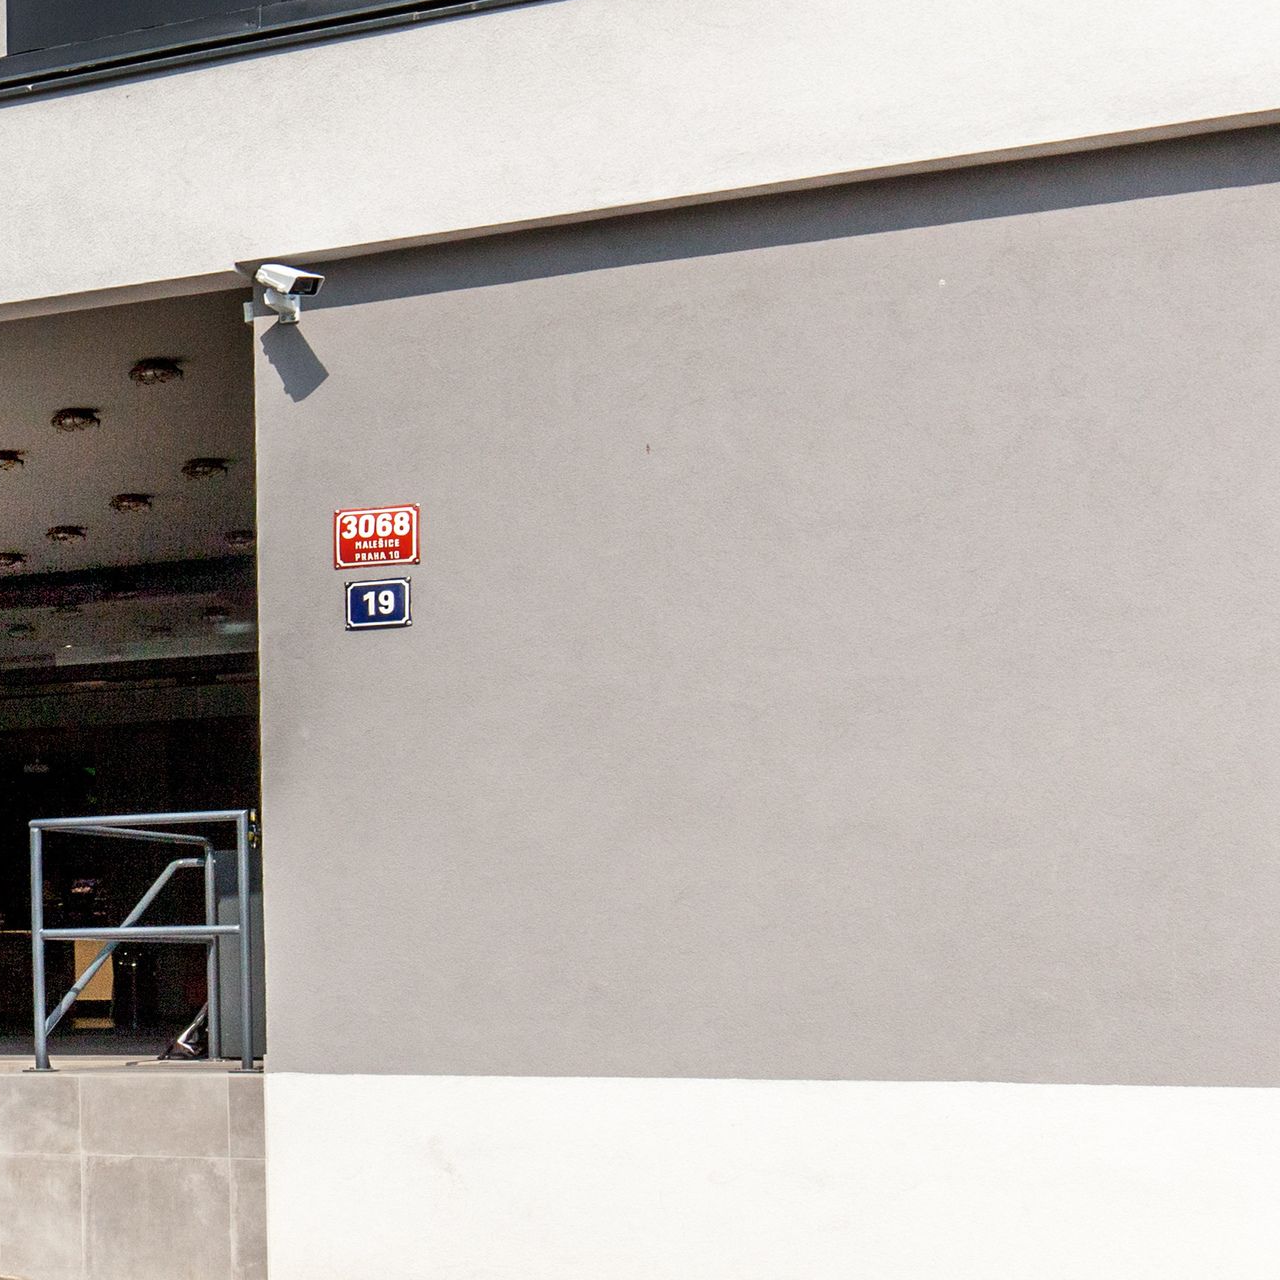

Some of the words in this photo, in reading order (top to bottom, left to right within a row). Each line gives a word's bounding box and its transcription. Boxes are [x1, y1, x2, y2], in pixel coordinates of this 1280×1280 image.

[341, 511, 411, 539] 3068
[355, 538, 400, 550] MALEŠICE
[355, 552, 387, 561] PRAHA
[389, 550, 400, 559] 10
[363, 590, 395, 616] 19
